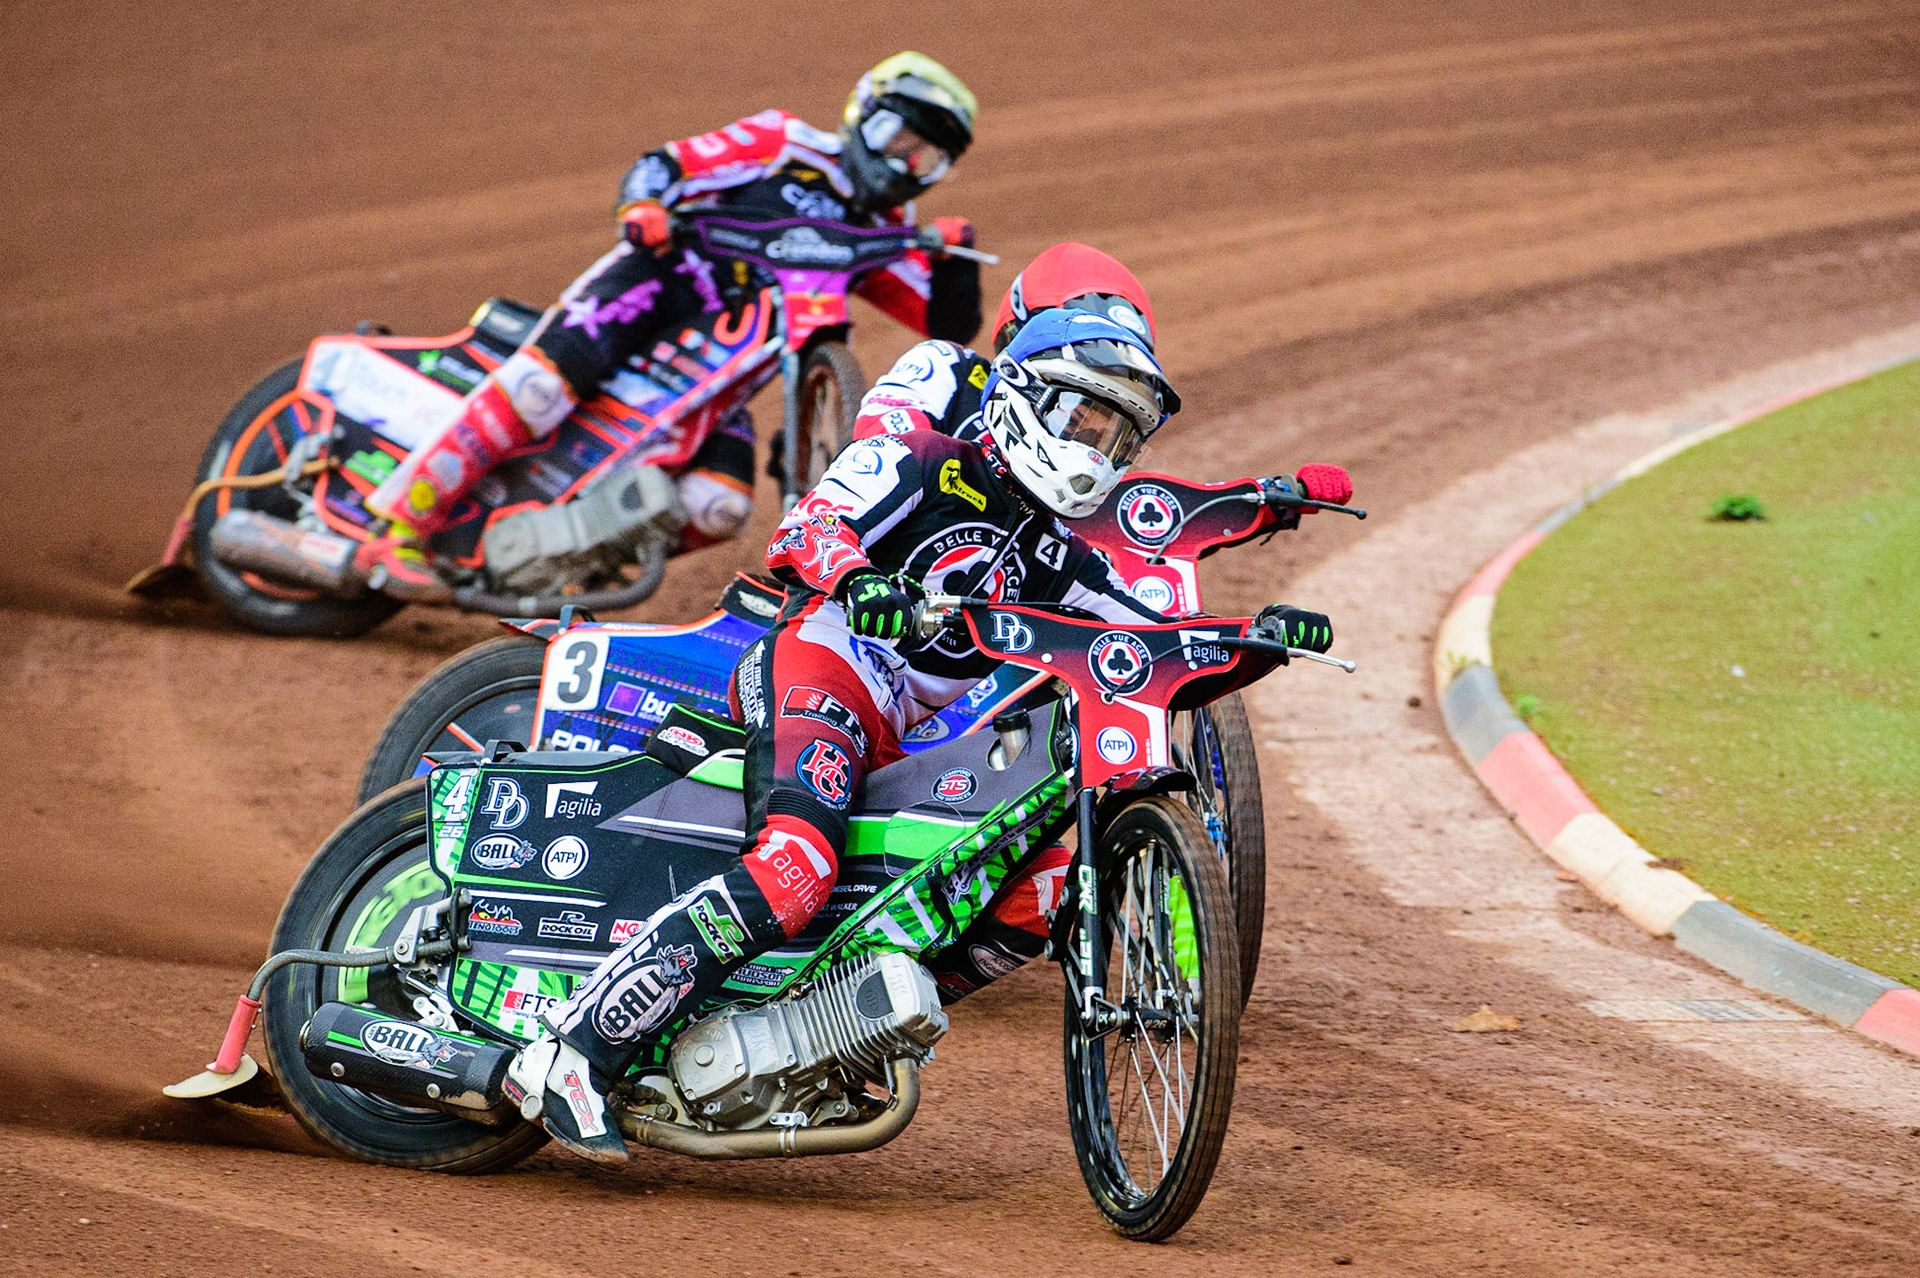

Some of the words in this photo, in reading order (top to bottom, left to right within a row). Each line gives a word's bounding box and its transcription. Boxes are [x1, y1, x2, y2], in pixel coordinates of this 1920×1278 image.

[1121, 490, 1140, 511] BELLE
[1140, 488, 1158, 496] VUE
[1159, 492, 1178, 511] ACES
[933, 530, 982, 553] BELLE
[1041, 540, 1059, 567] 4
[1140, 588, 1166, 599] ATPI
[1092, 636, 1111, 656] BELLE
[1112, 634, 1130, 643] VUE
[1131, 640, 1148, 660] ACES
[1193, 645, 1230, 664] agilia
[557, 640, 598, 704] 3
[1103, 740, 1128, 751] ATPI
[443, 775, 471, 814] 4
[938, 780, 968, 791] STS
[557, 798, 602, 819] agilia
[438, 825, 466, 838] 26
[550, 851, 579, 864] ATPI
[773, 852, 819, 915] agilia
[540, 923, 572, 935] ROCK
[572, 926, 594, 937] OIL
[696, 904, 722, 942] ROCK
[372, 1025, 429, 1053] BALL
